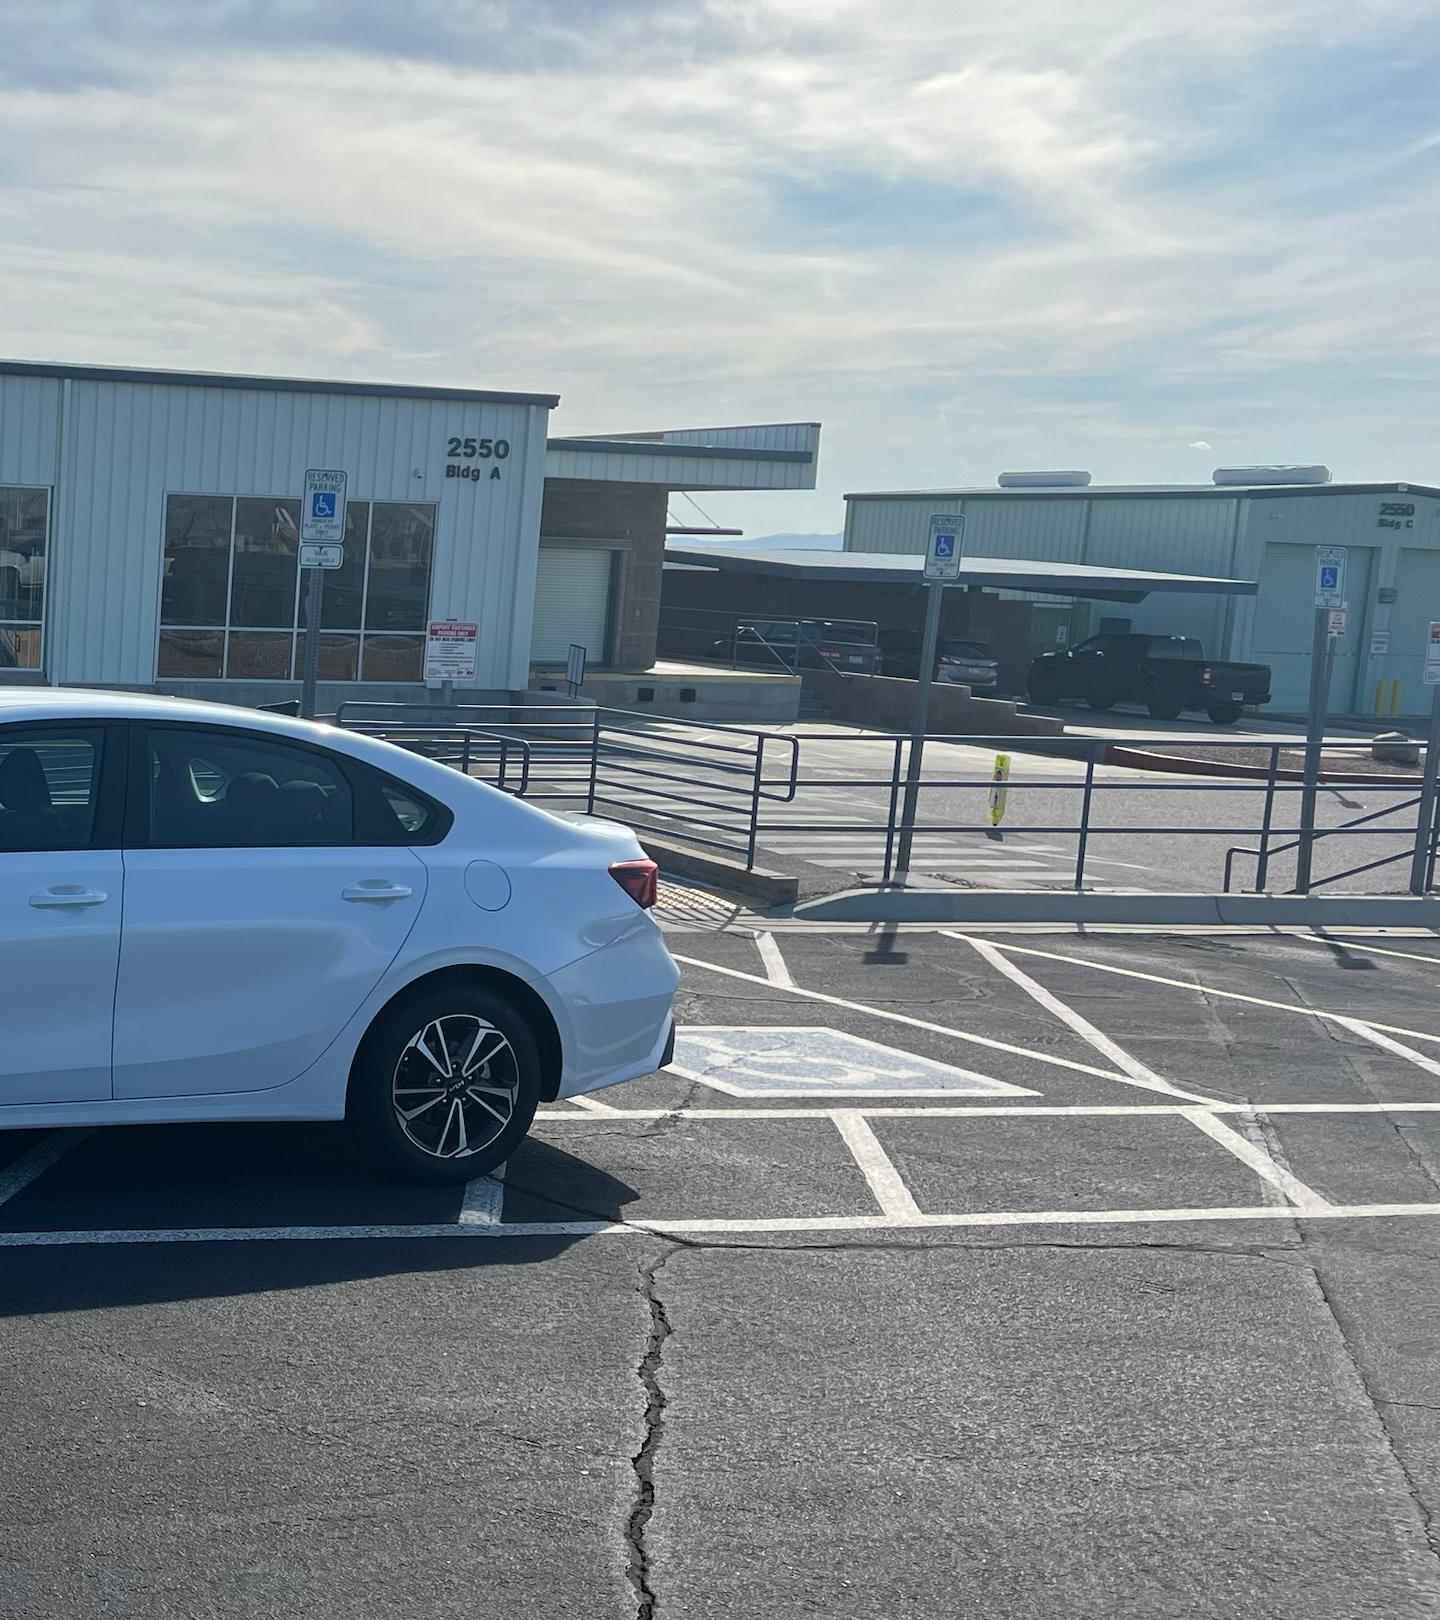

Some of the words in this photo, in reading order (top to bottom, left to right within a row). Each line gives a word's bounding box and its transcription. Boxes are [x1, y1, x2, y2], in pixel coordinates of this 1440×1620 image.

[447, 437, 510, 459] 2550
[307, 472, 344, 483] RESERVED
[446, 464, 481, 482] Bldg
[489, 466, 501, 480] A
[309, 482, 341, 493] PARKING
[1379, 502, 1415, 517] 2550
